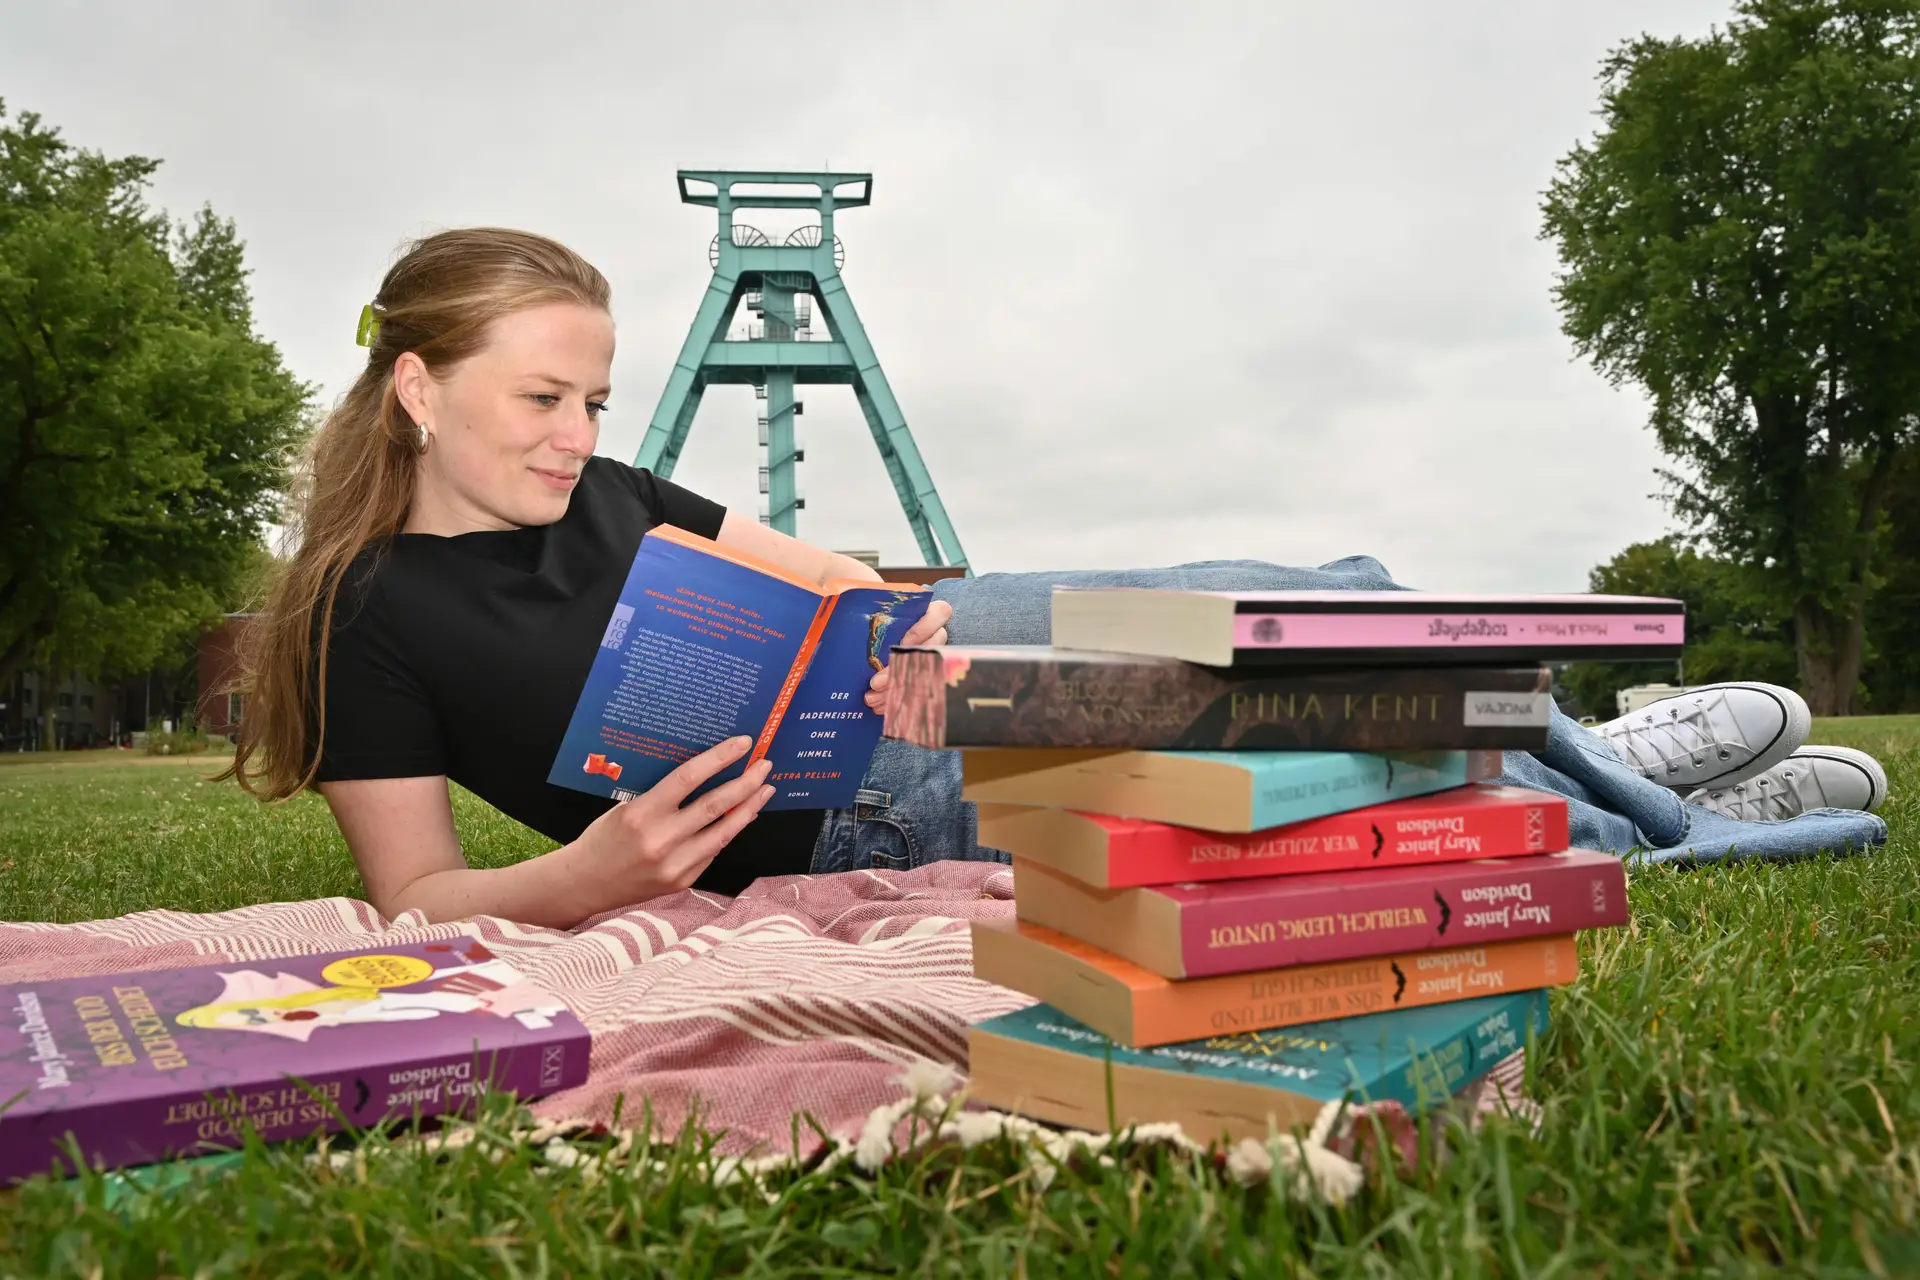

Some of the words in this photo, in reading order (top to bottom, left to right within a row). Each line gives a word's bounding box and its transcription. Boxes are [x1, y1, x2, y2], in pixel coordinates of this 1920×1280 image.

[615, 618, 629, 629] ro
[705, 607, 747, 625] Geschichte
[747, 621, 763, 631] und
[762, 627, 786, 639] dabei
[1428, 618, 1508, 641] totgepflegt
[610, 628, 624, 640] ro
[830, 692, 850, 700] DER
[799, 711, 864, 720] BADEMEISTER
[1230, 692, 1324, 721] PINA
[1344, 693, 1444, 722] KENT
[810, 731, 837, 739] OHNE
[796, 750, 833, 758] HIMMEL
[771, 772, 801, 781] PETRA
[804, 771, 841, 779] PELLINI
[1396, 816, 1464, 835] Davidson
[1323, 835, 1359, 853] WER
[1396, 836, 1443, 856] Janice
[1445, 835, 1481, 853] Mary
[1461, 883, 1532, 905] Davidson
[1337, 908, 1427, 933] WEIBLICH,
[1463, 906, 1510, 928] Janice
[1512, 903, 1551, 924] Mary
[1208, 921, 1275, 948] UNTOT
[1278, 915, 1335, 940] LEDIG,
[1416, 949, 1486, 972] Davidson
[1250, 977, 1286, 999] GUT
[1418, 973, 1463, 994] Janice
[1467, 969, 1504, 988] Mary
[1309, 994, 1341, 1014] WIE
[1210, 1009, 1254, 1030] UND
[389, 1062, 471, 1086] Davidson
[544, 1046, 562, 1084] LYX
[387, 1084, 442, 1106] Janice
[447, 1080, 489, 1097] Mary
